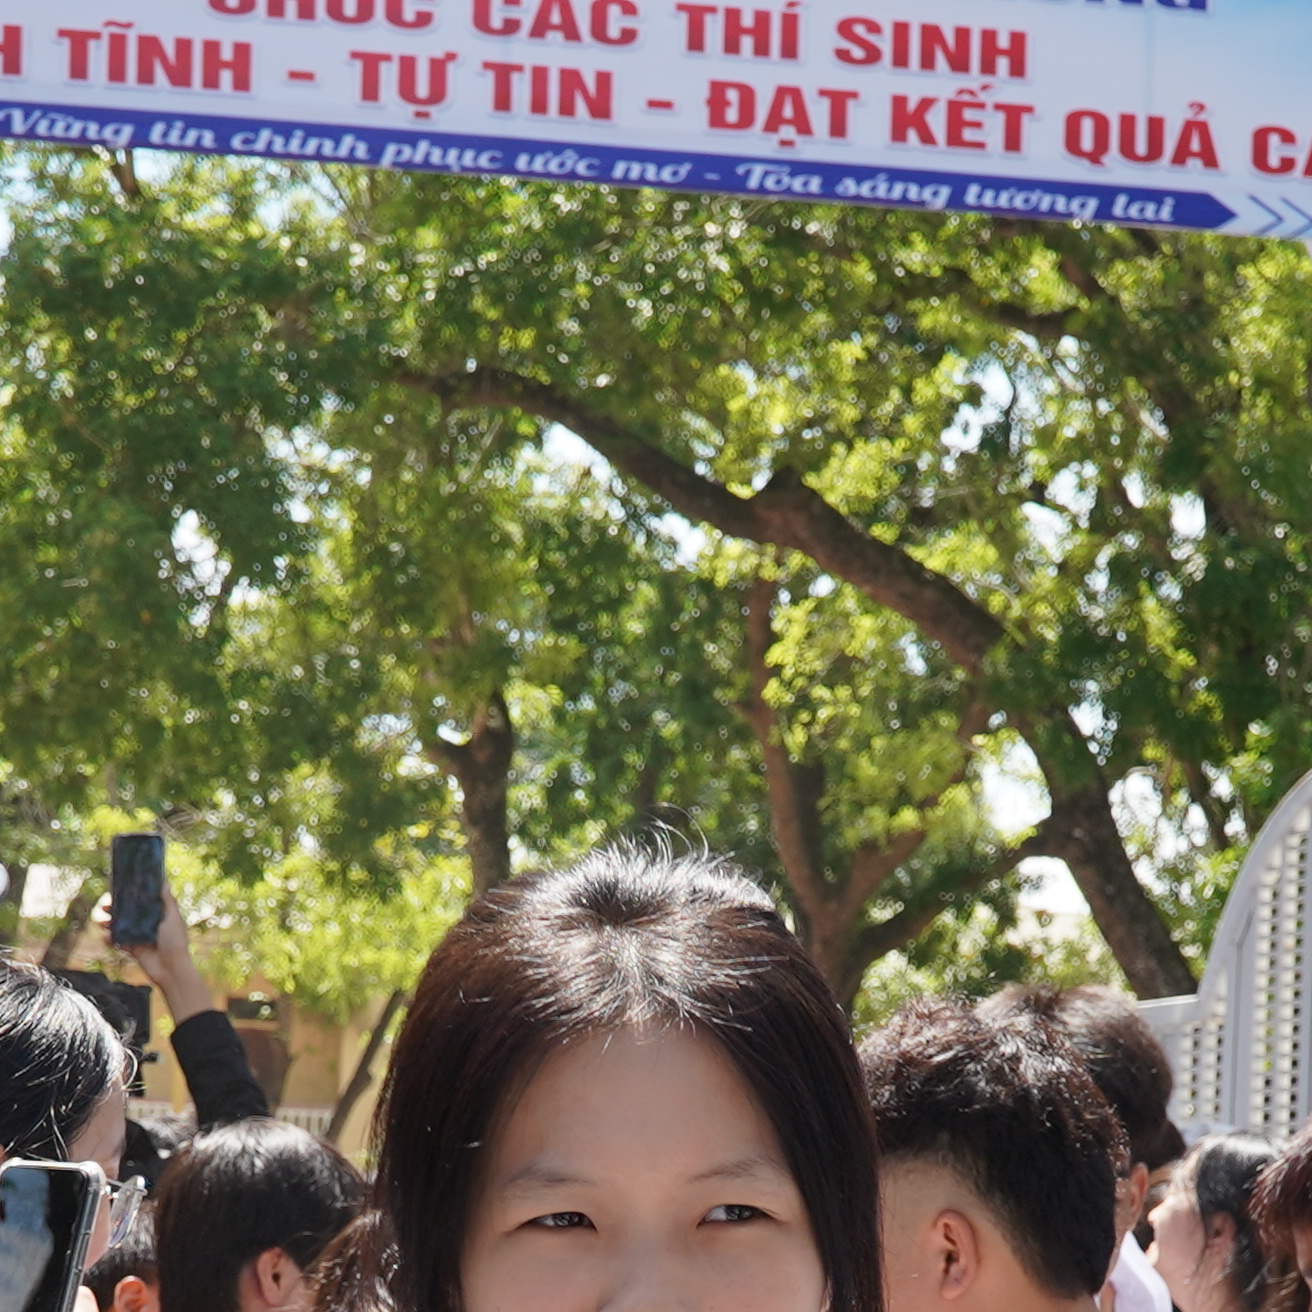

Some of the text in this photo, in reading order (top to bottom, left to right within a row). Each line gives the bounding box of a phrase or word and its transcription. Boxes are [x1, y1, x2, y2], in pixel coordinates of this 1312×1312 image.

[677, 1, 800, 61] THÍ
[835, 16, 1029, 79] SINH
[57, 20, 253, 93] TĨNH
[349, 50, 459, 120] TỰ
[482, 61, 614, 121] TIN
[706, 79, 860, 148] ĐẠT
[890, 83, 1035, 154] KẾT
[1063, 102, 1220, 171] QUẢ
[148, 120, 218, 149] tin
[230, 127, 372, 161] chinh
[379, 138, 504, 173] phục
[514, 148, 602, 178] ước
[611, 158, 694, 184] mơ
[835, 172, 954, 210] sáng
[963, 183, 1099, 221] tương
[1111, 193, 1176, 223] lai
